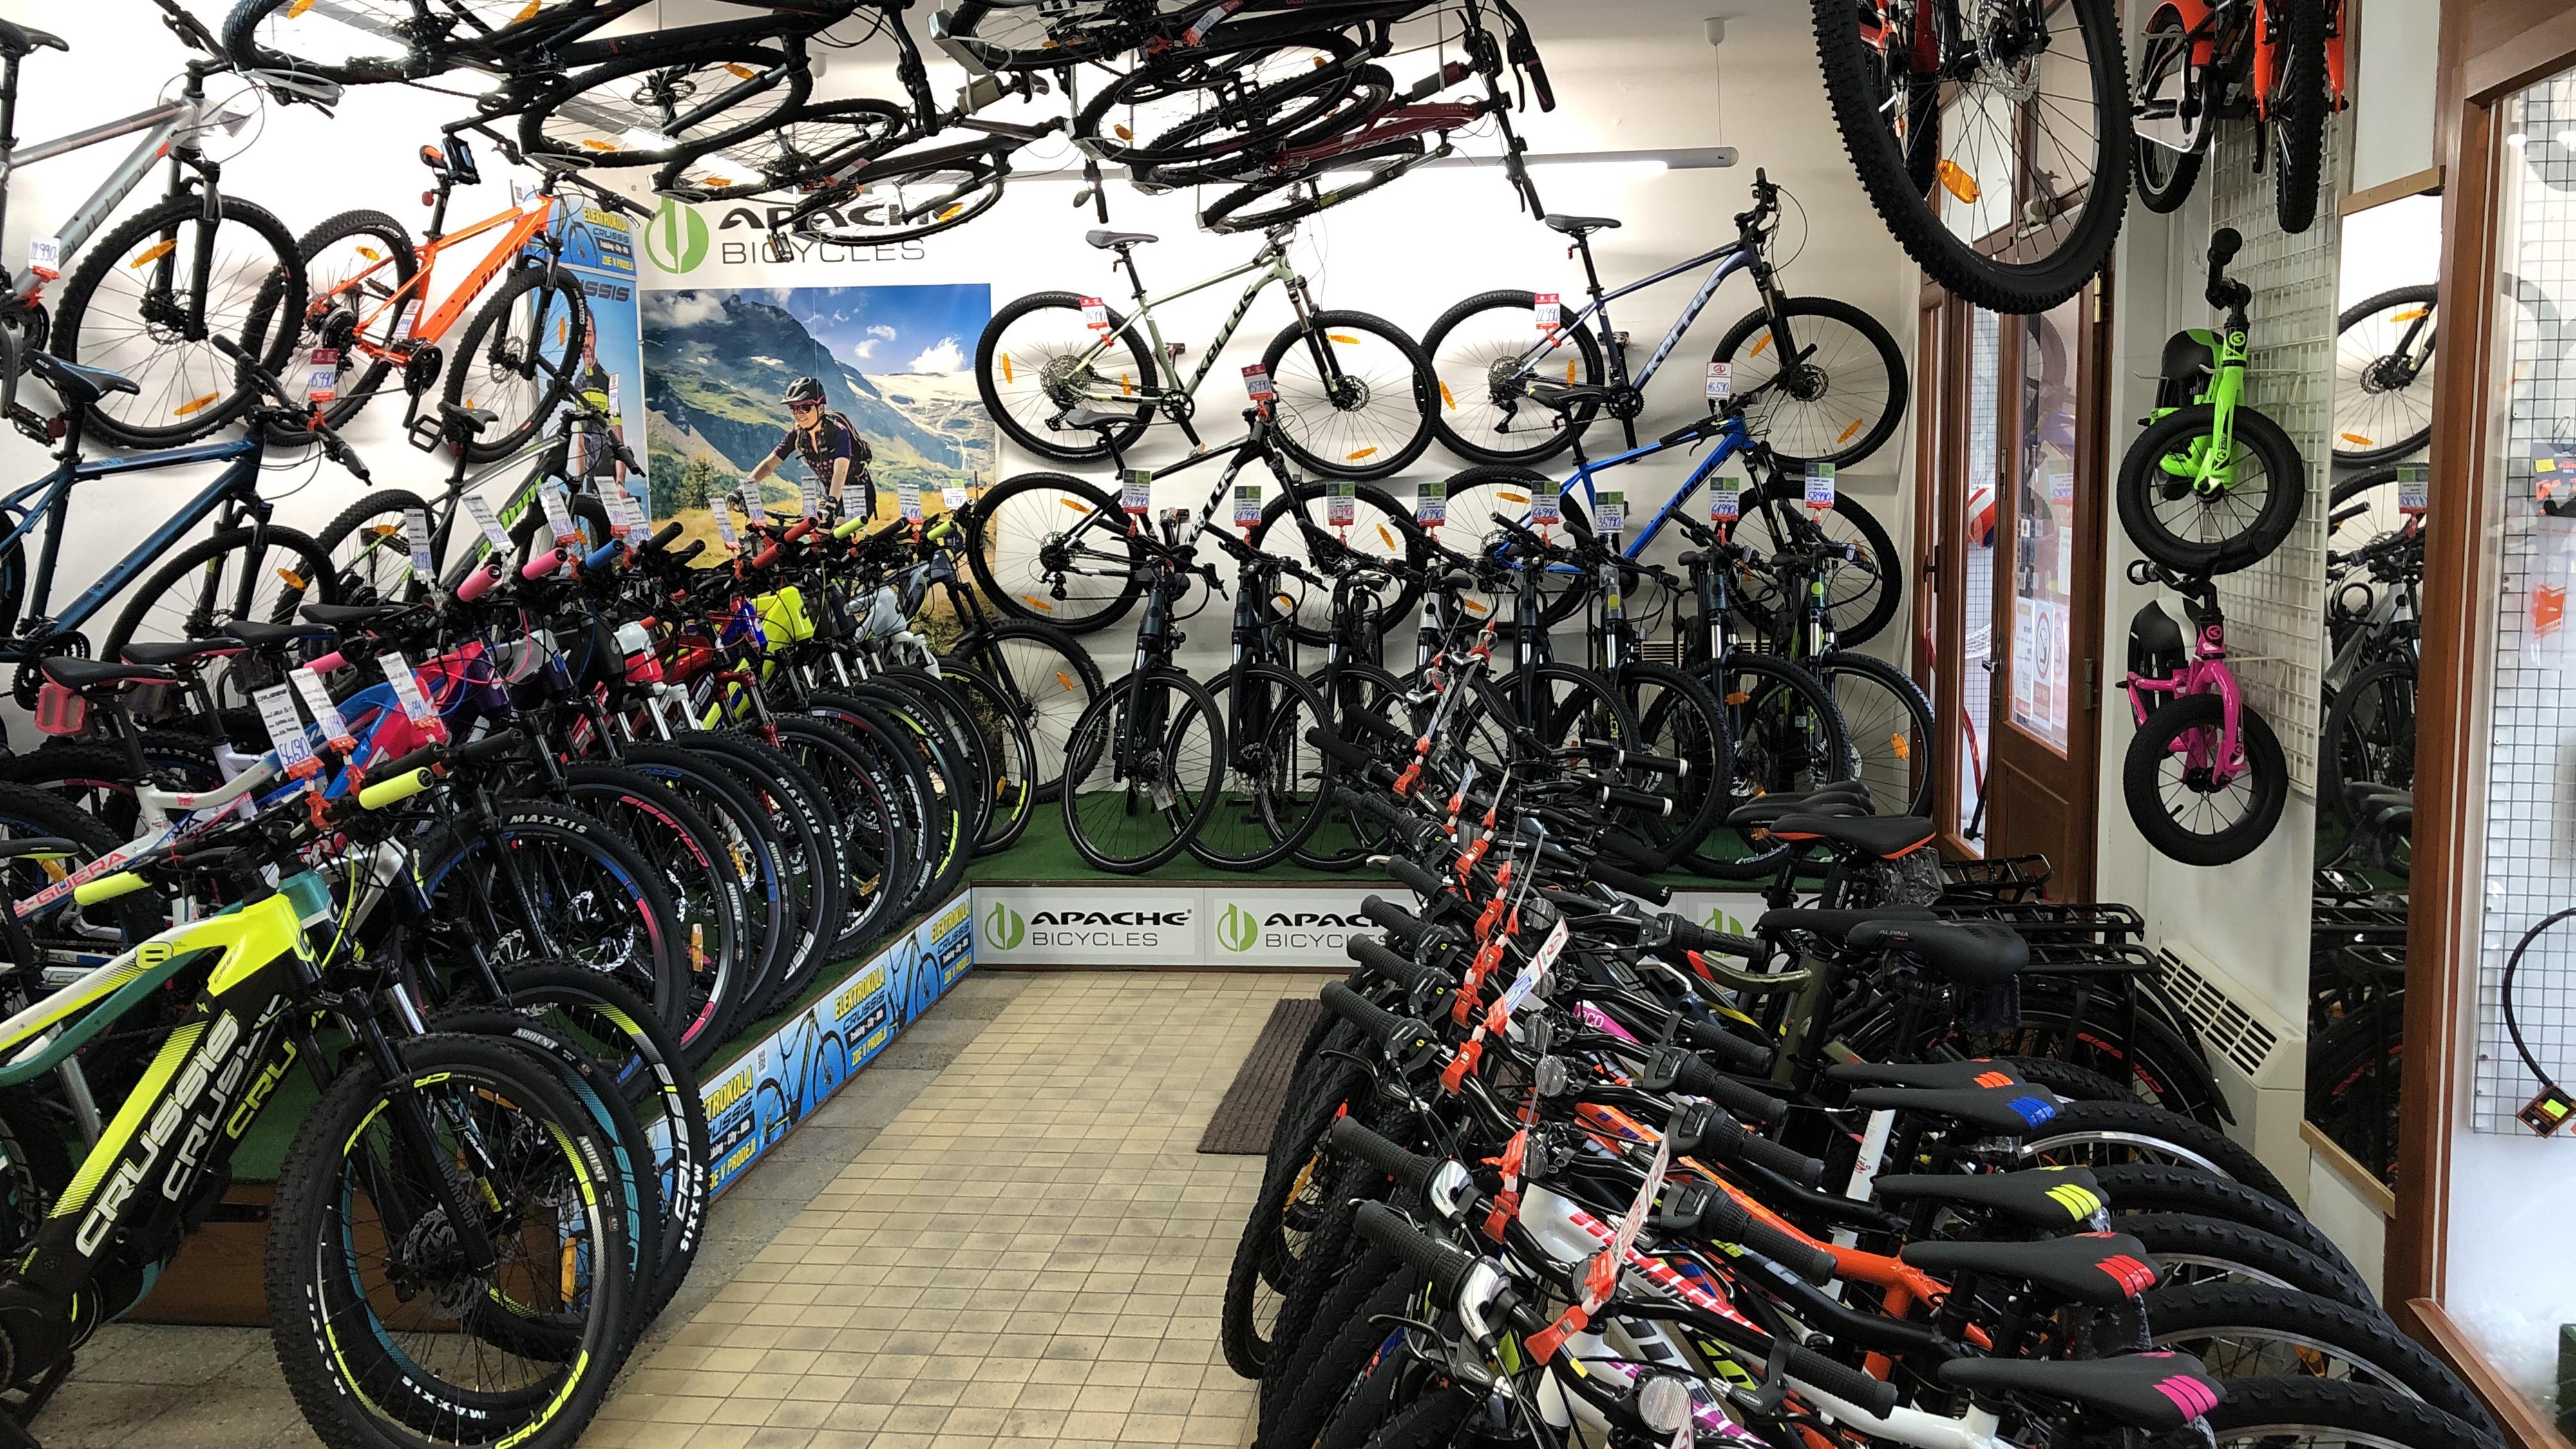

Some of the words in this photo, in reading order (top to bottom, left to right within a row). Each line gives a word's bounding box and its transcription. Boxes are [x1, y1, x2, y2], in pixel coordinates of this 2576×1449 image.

[722, 239, 925, 264] BICYCLES
[903, 704, 944, 745] MAXXIS
[776, 777, 820, 835] MAXXIS
[870, 771, 900, 829] MAXXIS
[509, 814, 588, 834] MAXXIS
[13, 853, 128, 918] E-GUERA
[931, 898, 970, 945] ELEKTROKOLA
[1032, 932, 1158, 947] BICYCLES
[835, 964, 885, 1022] ELEKTROKOLA
[852, 1048, 862, 1066] ZDE
[76, 1009, 239, 1257] CRUSSIS
[654, 1063, 690, 1222] CRUSSIS
[727, 1133, 737, 1144] City
[577, 1136, 609, 1183] ARDENT
[720, 1164, 726, 1181] V
[680, 1162, 704, 1253] MAXXIS
[1465, 1363, 1489, 1381] TEKTRO
